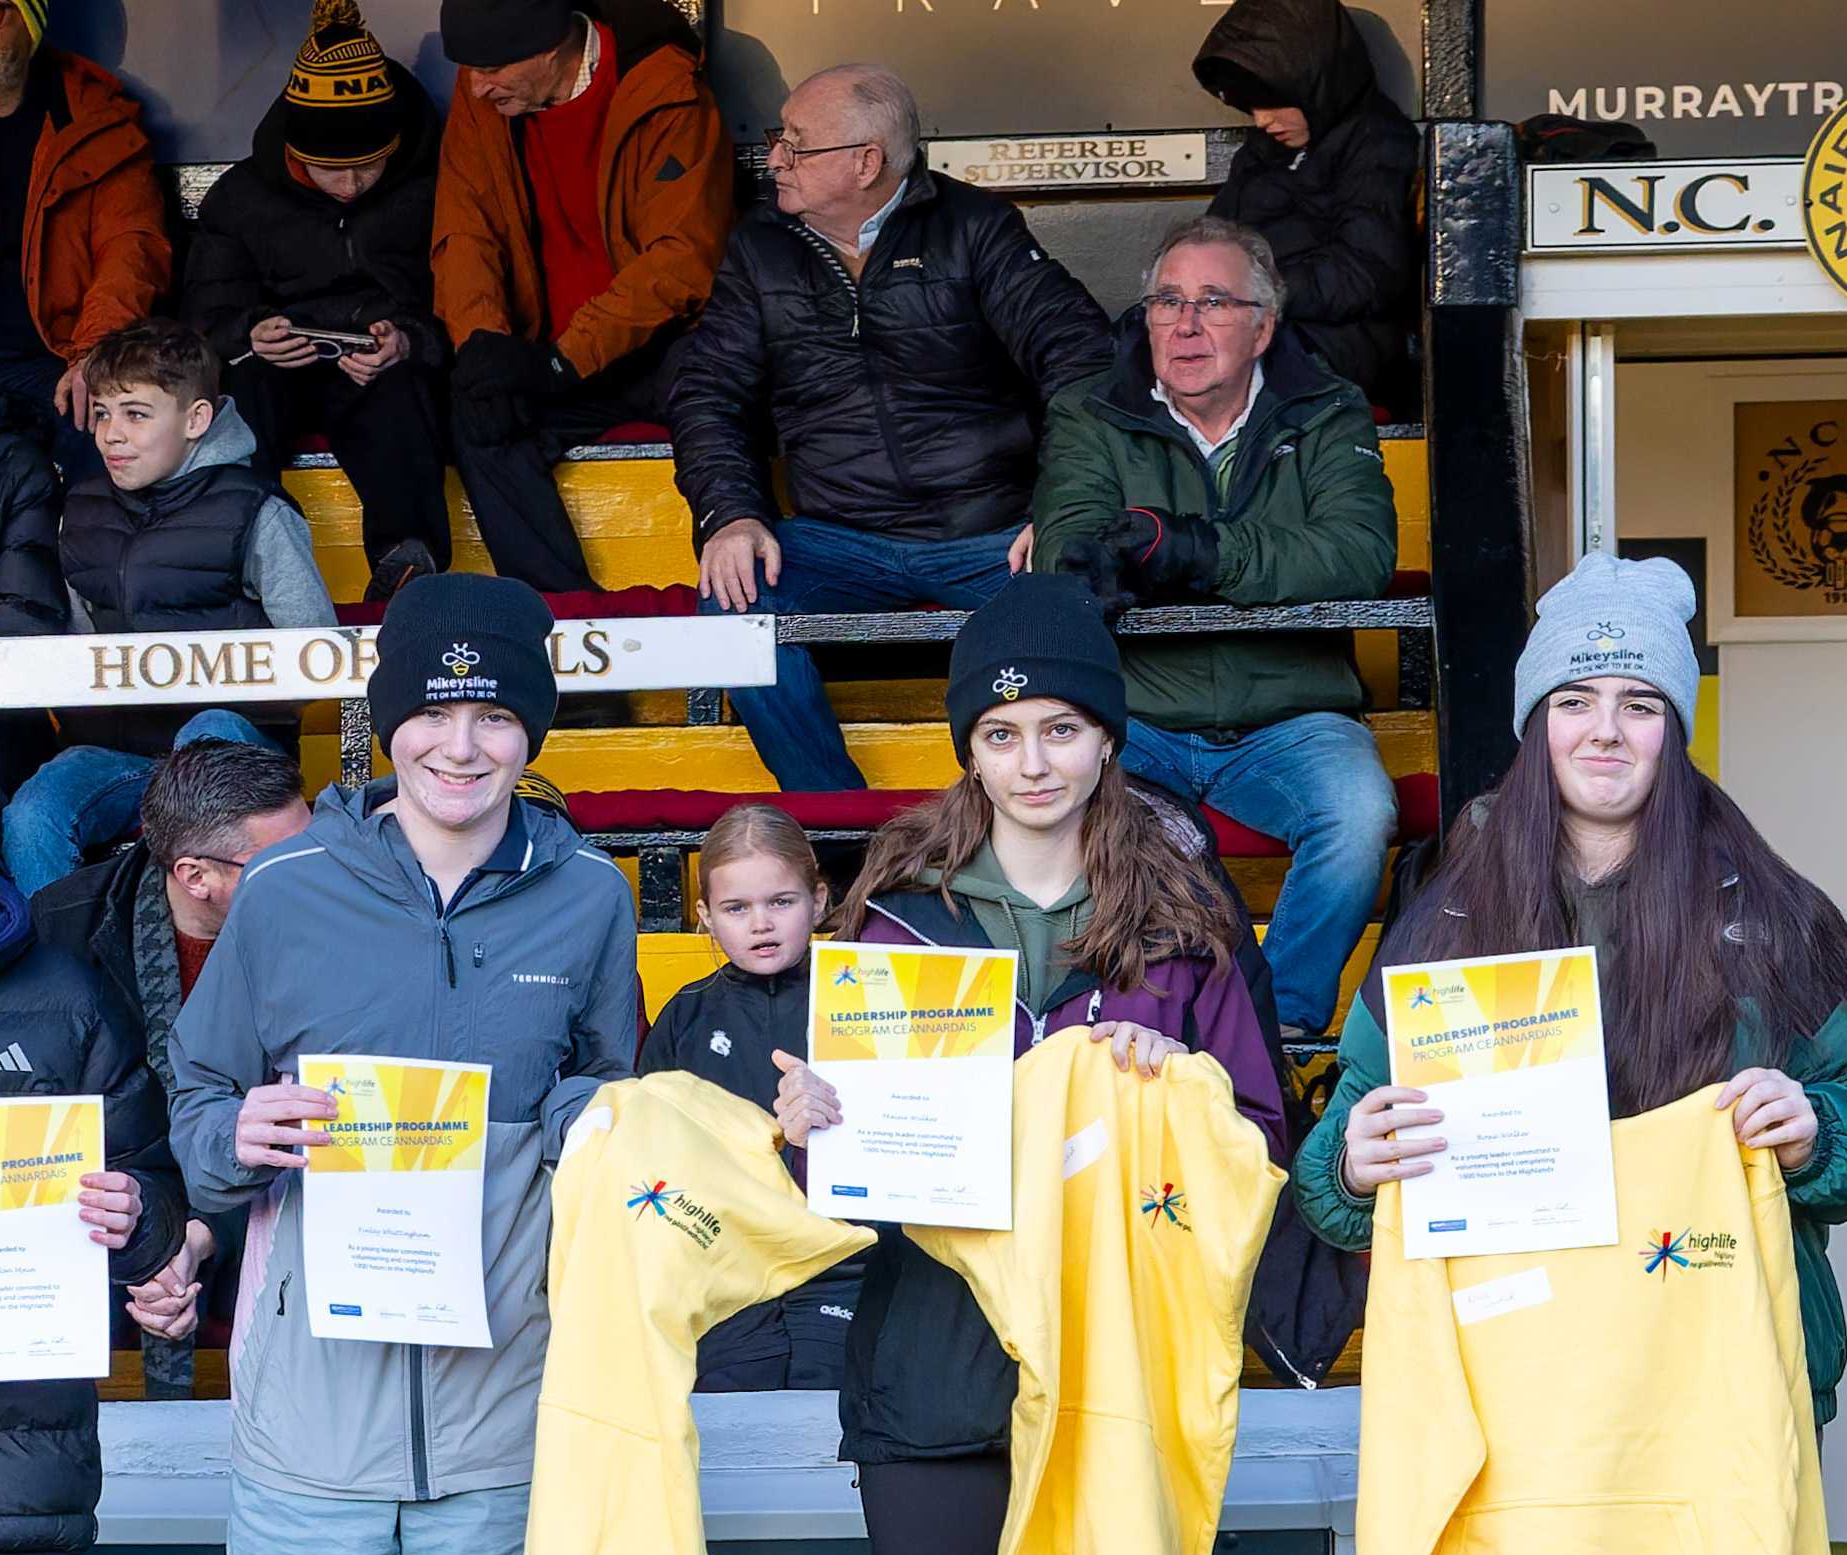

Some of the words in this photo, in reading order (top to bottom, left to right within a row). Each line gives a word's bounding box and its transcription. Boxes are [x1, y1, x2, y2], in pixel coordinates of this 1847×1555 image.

[988, 140, 1147, 161] REFEREE
[964, 160, 1170, 183] SUPERVISOR
[1574, 172, 1776, 237] N.C.
[89, 640, 277, 690] HOME
[1570, 649, 1644, 665] Mikeysline
[426, 676, 498, 691] Mikeysline
[830, 1010, 908, 1022] LEADERSHIP
[910, 1007, 995, 1019] PROGRAMME
[830, 1023, 891, 1036] PROGRAM
[893, 1022, 977, 1036] CEANNARDAIS
[1411, 1024, 1490, 1047] LEADERSHIP
[1493, 1008, 1579, 1031] PROGRAMME
[1412, 1043, 1475, 1062] PROGRAM
[1476, 1026, 1563, 1050] CEANNARDAIS
[323, 1122, 392, 1133] LEADERSHIP
[395, 1121, 469, 1132] PROGRAMME
[379, 1135, 453, 1146] CEANNARDAIS
[1, 1151, 84, 1169] PROGRAMME
[674, 1194, 721, 1237] highlife
[1688, 1232, 1738, 1253] highlife
